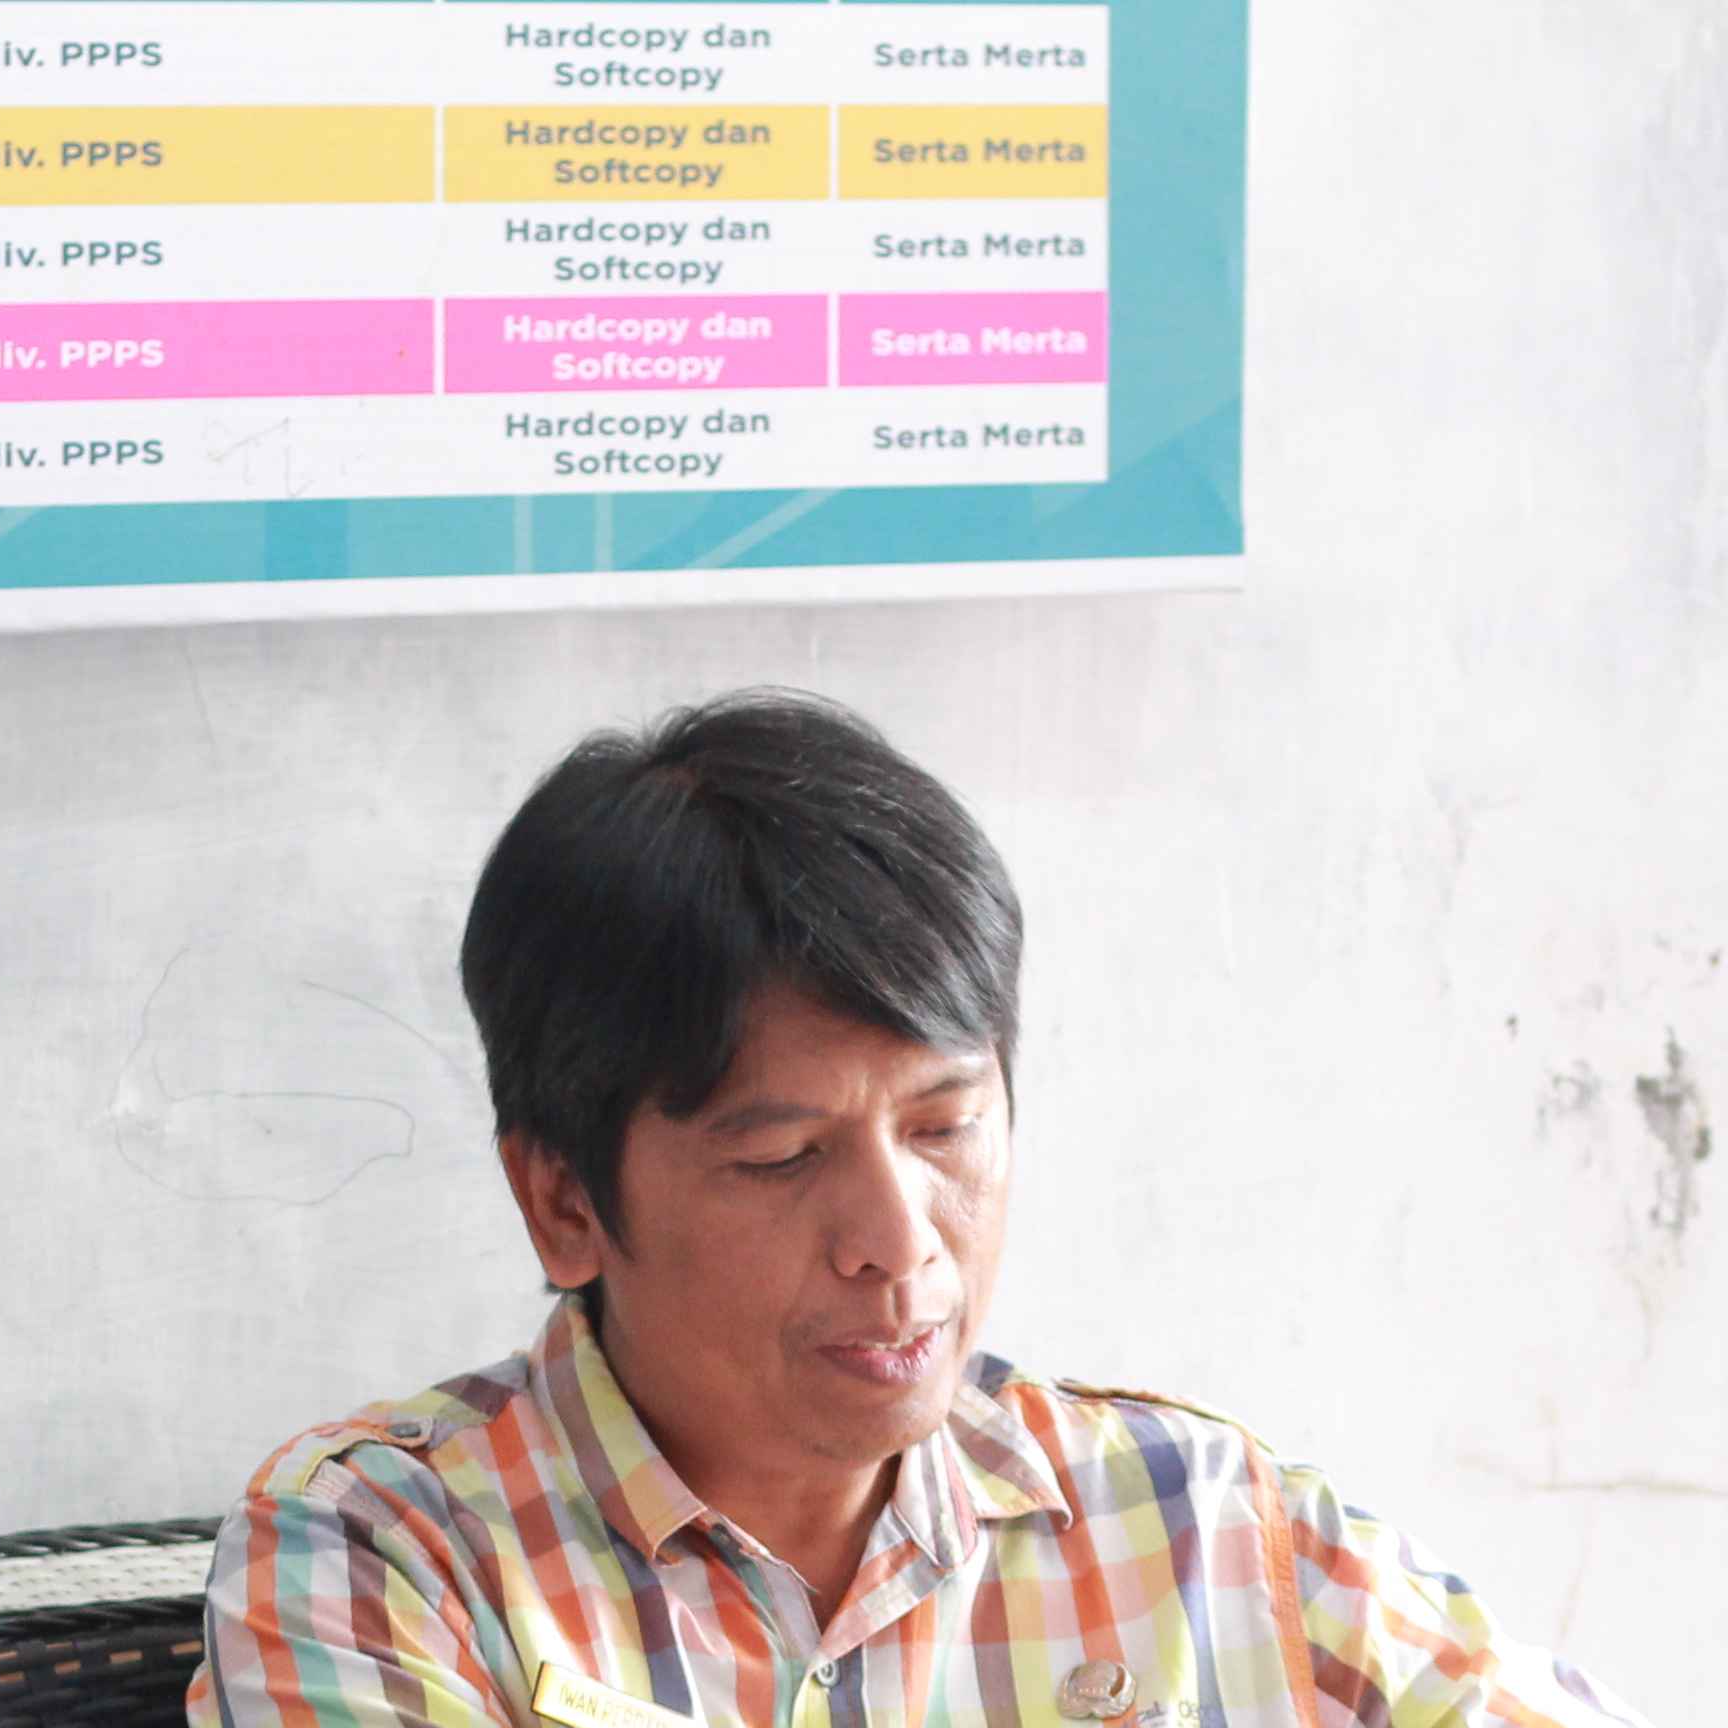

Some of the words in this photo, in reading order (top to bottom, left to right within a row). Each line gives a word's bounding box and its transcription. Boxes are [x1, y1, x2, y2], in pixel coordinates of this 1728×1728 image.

[506, 23, 688, 52] Hardcopy
[703, 24, 770, 48] dan
[62, 42, 162, 66] PPPS
[875, 43, 968, 67] Serta
[984, 44, 1085, 67] Merta
[555, 61, 723, 91] Softcopy
[506, 120, 688, 149] Hardcopy
[703, 120, 770, 144] dan
[61, 141, 162, 167] PPPS
[874, 138, 968, 163] Serta
[984, 138, 1085, 163] Merta
[555, 158, 723, 188] Softcopy
[506, 218, 688, 246] Hardcopy
[702, 217, 770, 240] dan
[62, 241, 162, 266] PPPS
[874, 234, 968, 258] Serta
[984, 234, 1085, 257] Merta
[555, 256, 722, 284] Softcopy
[504, 313, 690, 345] Hardcopy
[700, 312, 771, 339] dan
[872, 329, 970, 356] Serta
[981, 327, 1087, 354] Merta
[60, 340, 164, 368] PPPS
[553, 352, 725, 383] Softcopy
[506, 412, 688, 440] Hardcopy
[702, 409, 769, 434] dan
[874, 426, 968, 449] Serta
[984, 424, 1084, 446] Merta
[63, 440, 163, 466] PPPS
[555, 449, 722, 477] Softcopy
